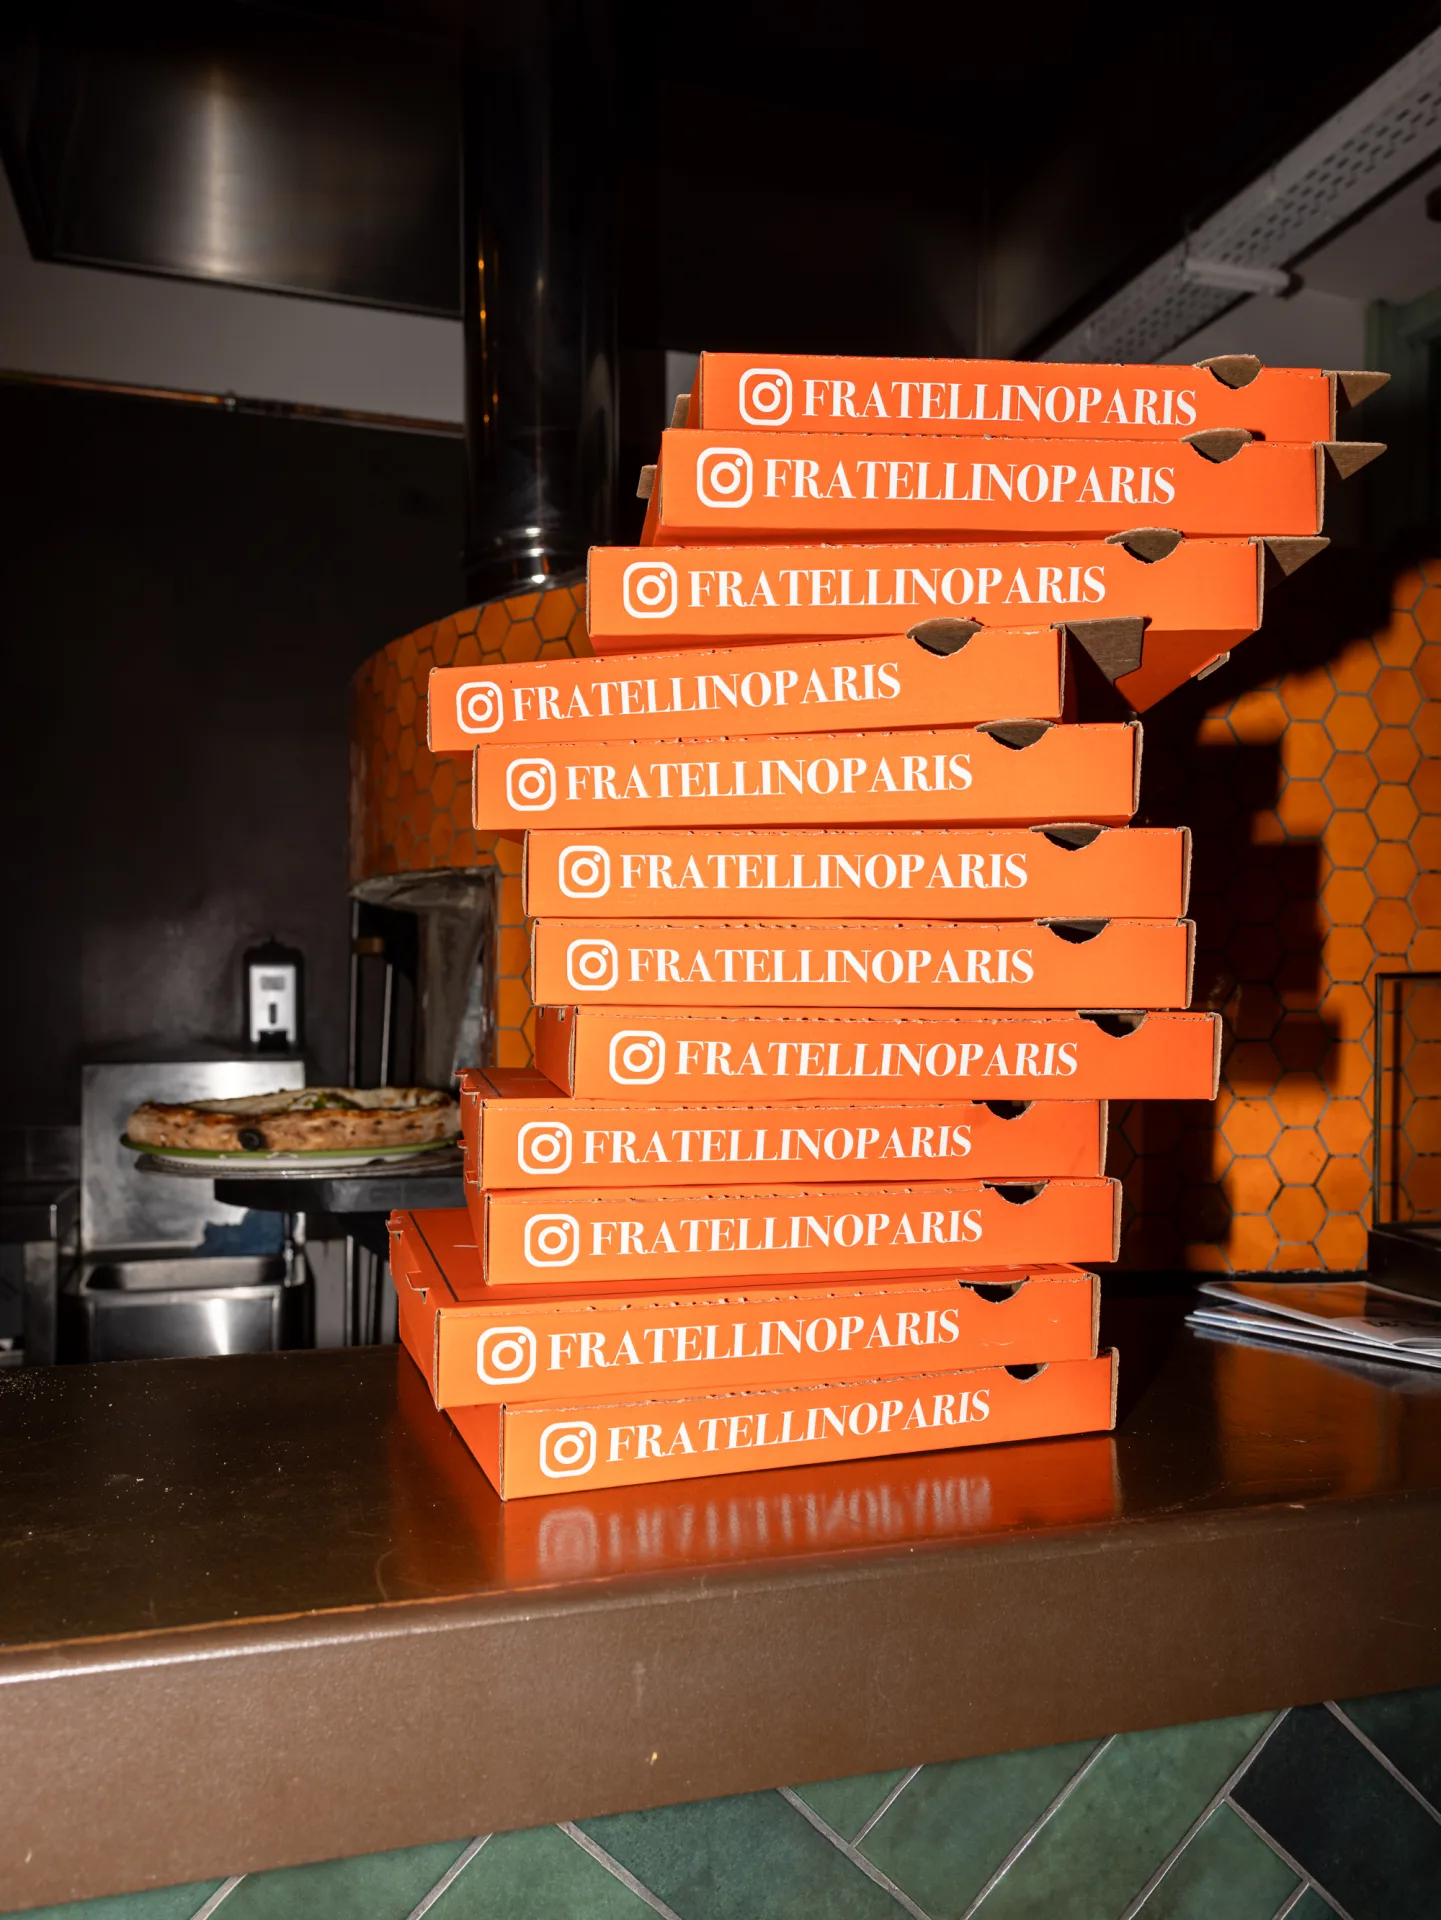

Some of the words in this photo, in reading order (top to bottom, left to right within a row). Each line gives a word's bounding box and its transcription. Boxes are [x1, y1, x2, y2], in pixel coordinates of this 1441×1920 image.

[802, 379, 1197, 426] FRATELLINOPARIS
[763, 458, 1175, 505] FRATELLINOPARIS
[687, 565, 1106, 608] FRATELLINOPARIS
[511, 662, 901, 722] FRATELLINOPARIS
[565, 753, 973, 801] FRATELLINOPARIS
[619, 853, 1028, 889] FRATELLINOPARIS
[627, 948, 1034, 984] FRATELLINOPARIS
[674, 1040, 1078, 1077] FRATELLINOPARIS
[582, 1125, 972, 1164] FRATELLINOPARIS
[589, 1209, 983, 1256] FRATELLINOPARIS
[546, 1309, 960, 1371] FRATELLINOPARIS
[605, 1389, 990, 1463] FRATELLINOPARIS
